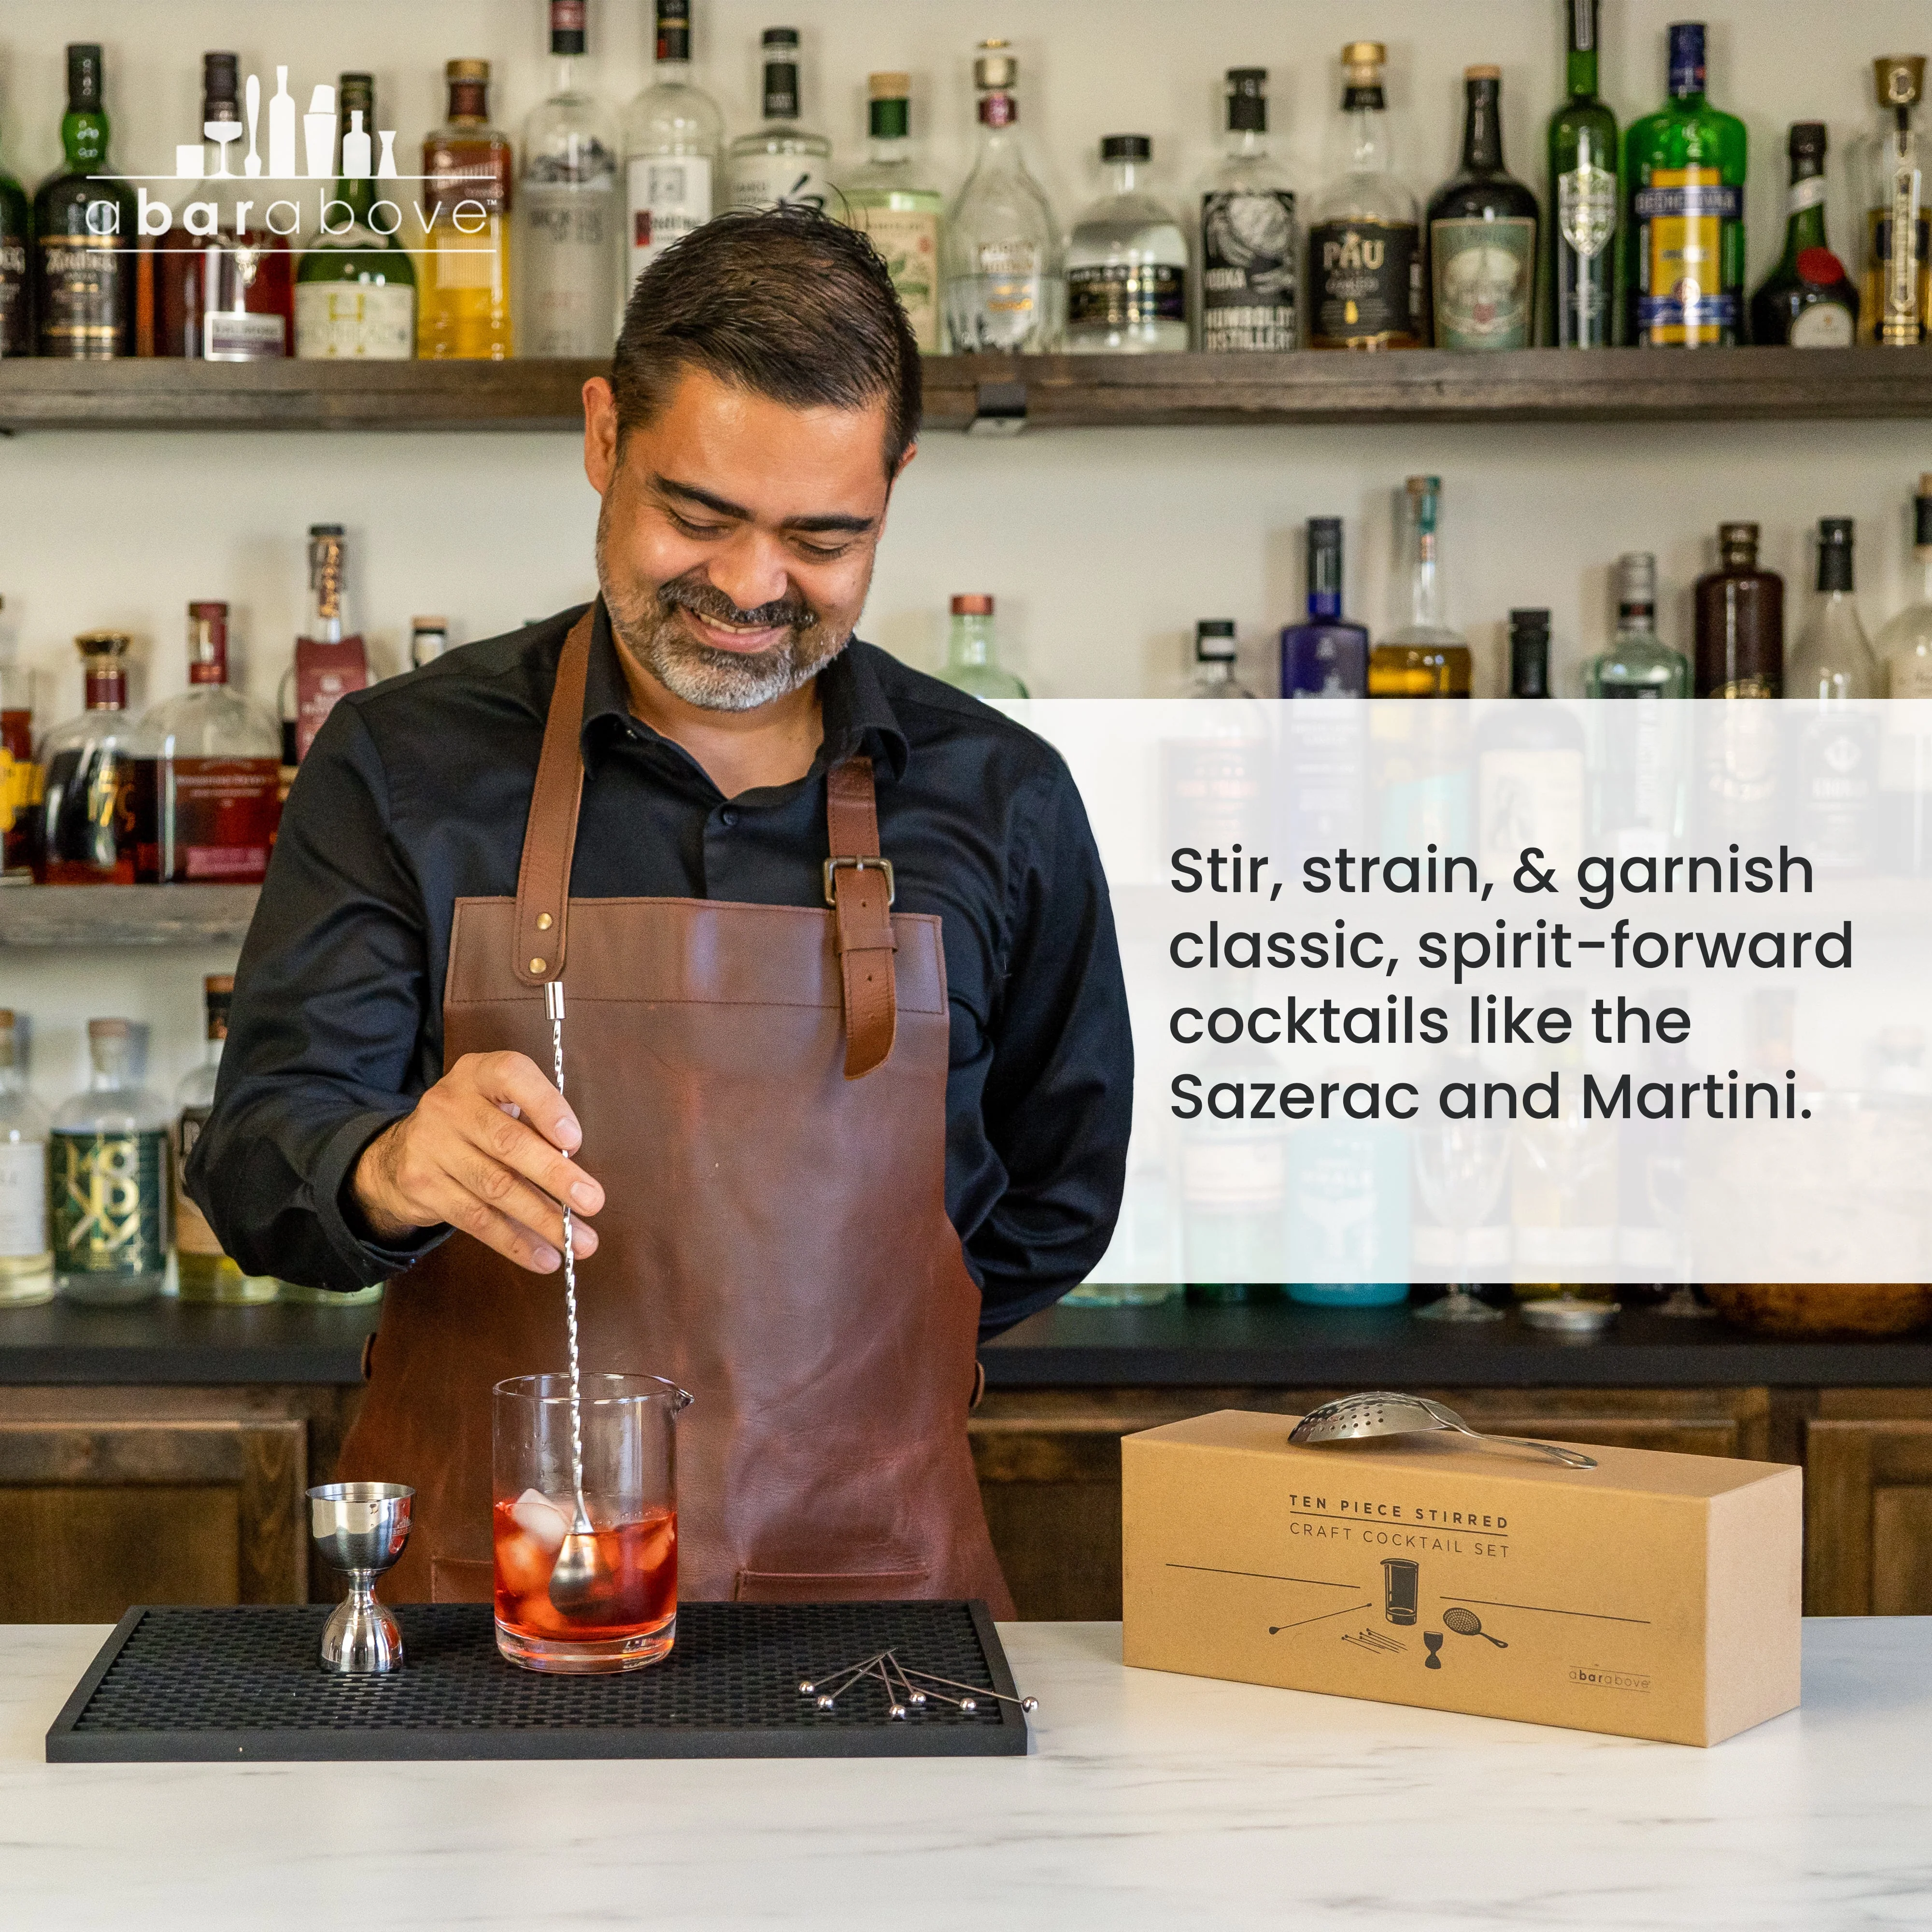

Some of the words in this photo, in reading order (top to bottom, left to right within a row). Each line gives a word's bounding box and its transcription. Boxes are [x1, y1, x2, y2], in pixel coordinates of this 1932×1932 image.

[1289, 1494, 1326, 1509] TEN
[1341, 1500, 1401, 1517] PIECE
[1416, 1508, 1507, 1528] STIRRED
[1290, 1522, 1351, 1540] CRAFT
[1363, 1531, 1462, 1552] COCKTAIL
[1475, 1543, 1509, 1558] SET
